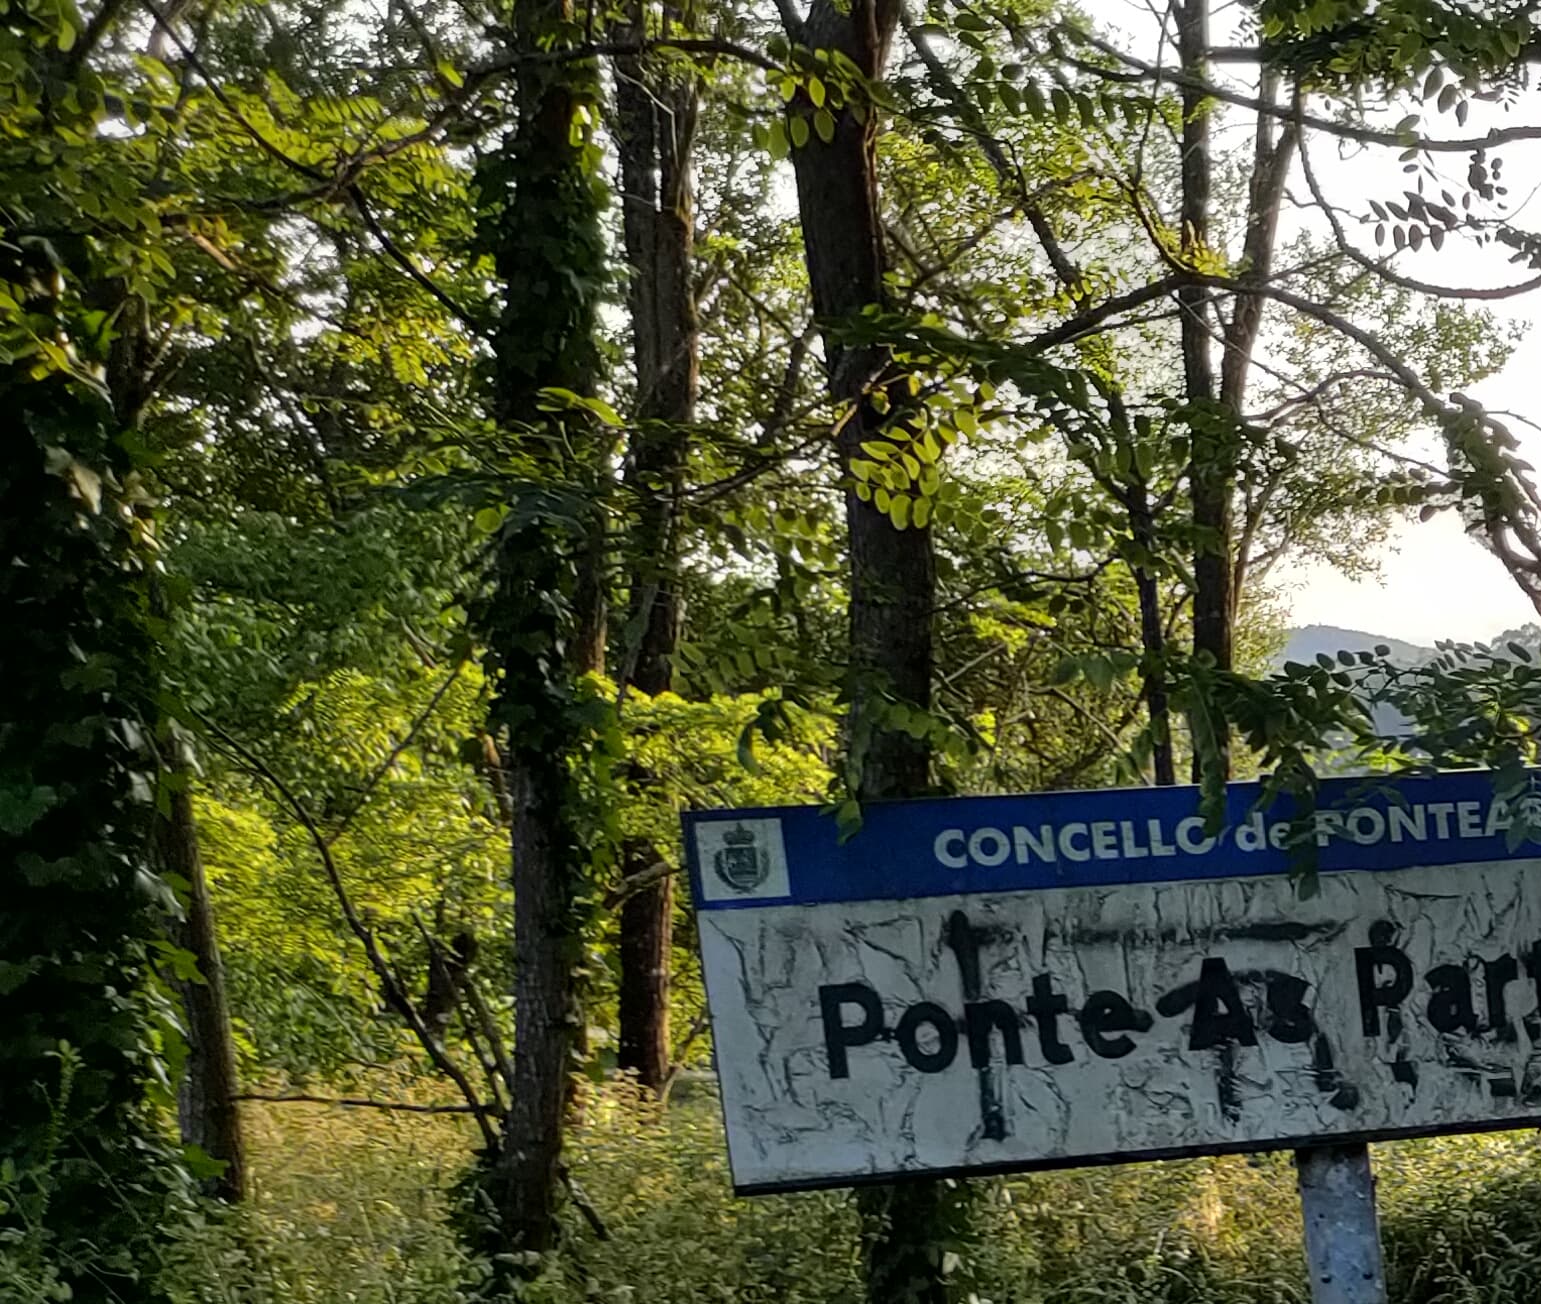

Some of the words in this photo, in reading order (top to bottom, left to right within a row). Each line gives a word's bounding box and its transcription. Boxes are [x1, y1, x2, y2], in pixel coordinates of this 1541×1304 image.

[934, 816, 1218, 868] CONCELLO
[1235, 811, 1293, 852] de
[818, 972, 1140, 1080] Ponte
